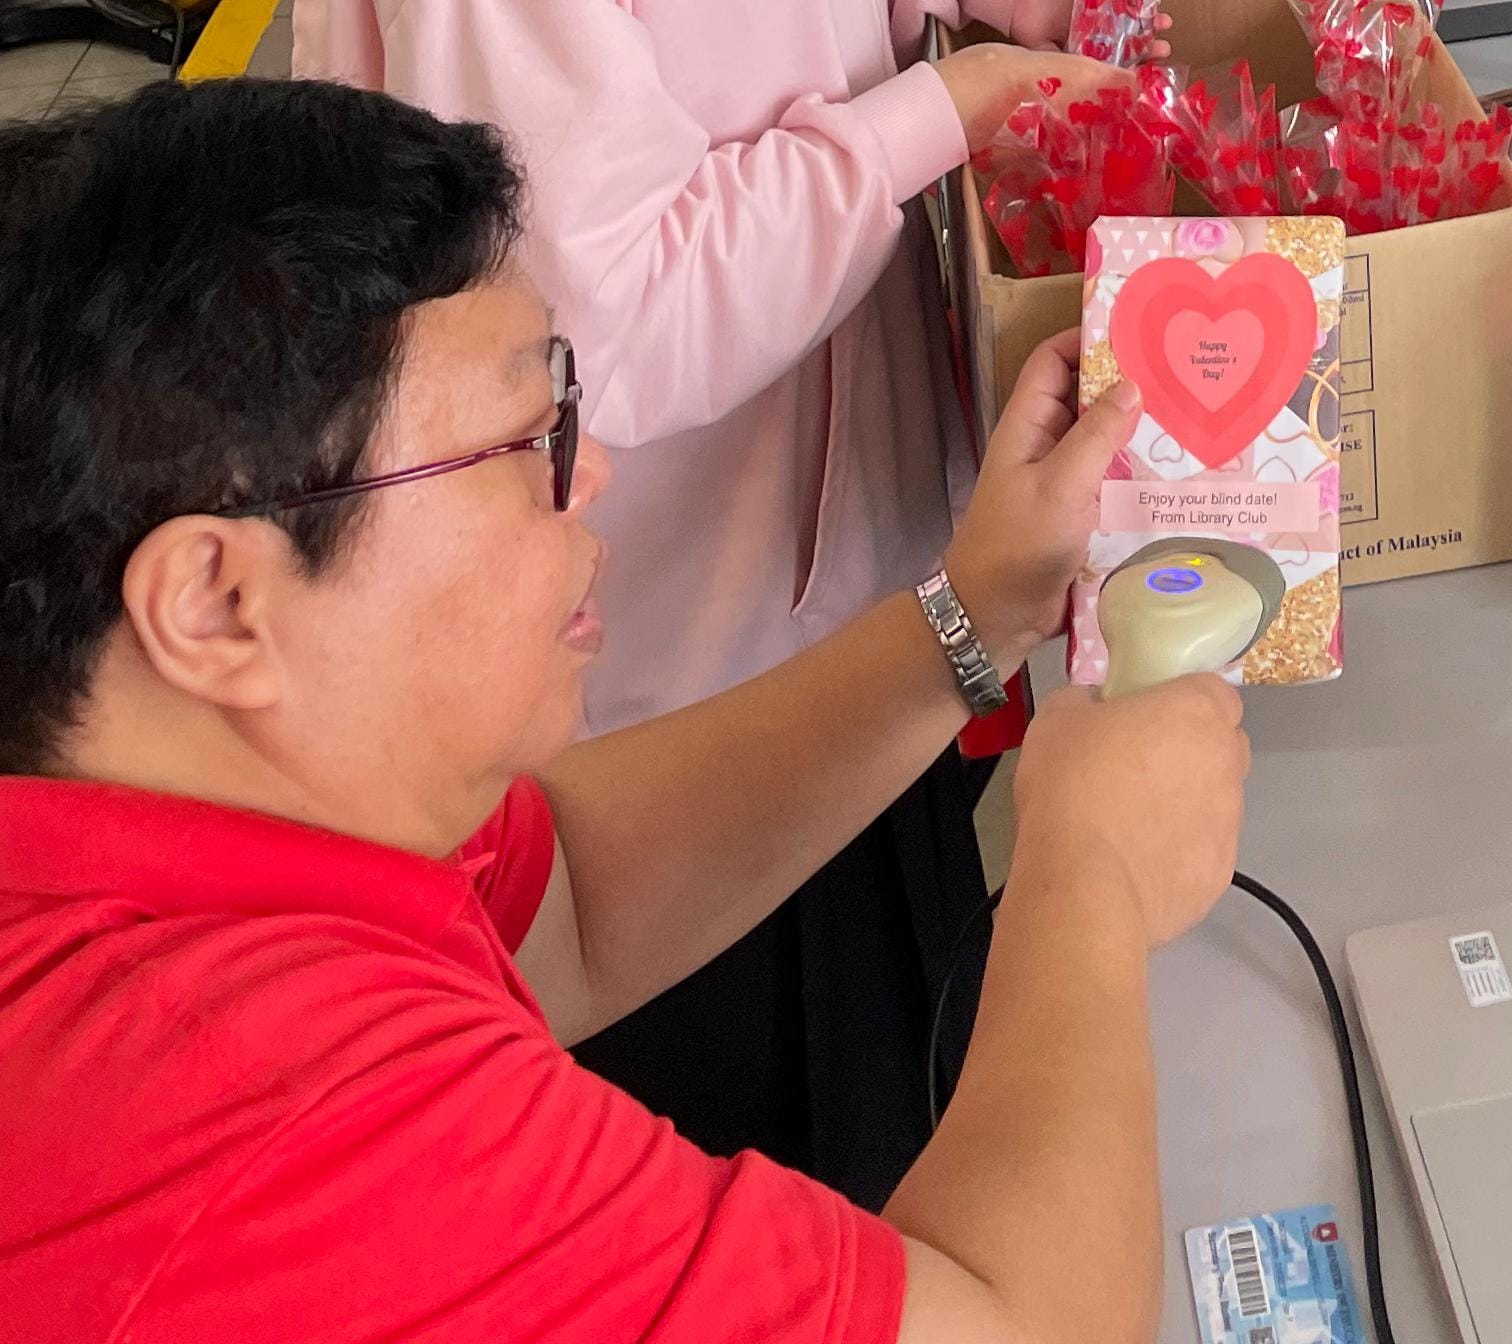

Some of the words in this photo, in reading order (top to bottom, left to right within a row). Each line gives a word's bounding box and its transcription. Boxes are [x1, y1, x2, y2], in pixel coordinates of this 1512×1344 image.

[1138, 492, 1176, 507] Enjoy
[1179, 494, 1207, 507] your
[1211, 493, 1241, 506] blind
[1245, 493, 1278, 506] date!
[1152, 511, 1186, 524] From
[1190, 511, 1234, 527] Library
[1238, 511, 1268, 524] Club
[1366, 540, 1384, 557] of
[1388, 528, 1463, 553] Malaysia
